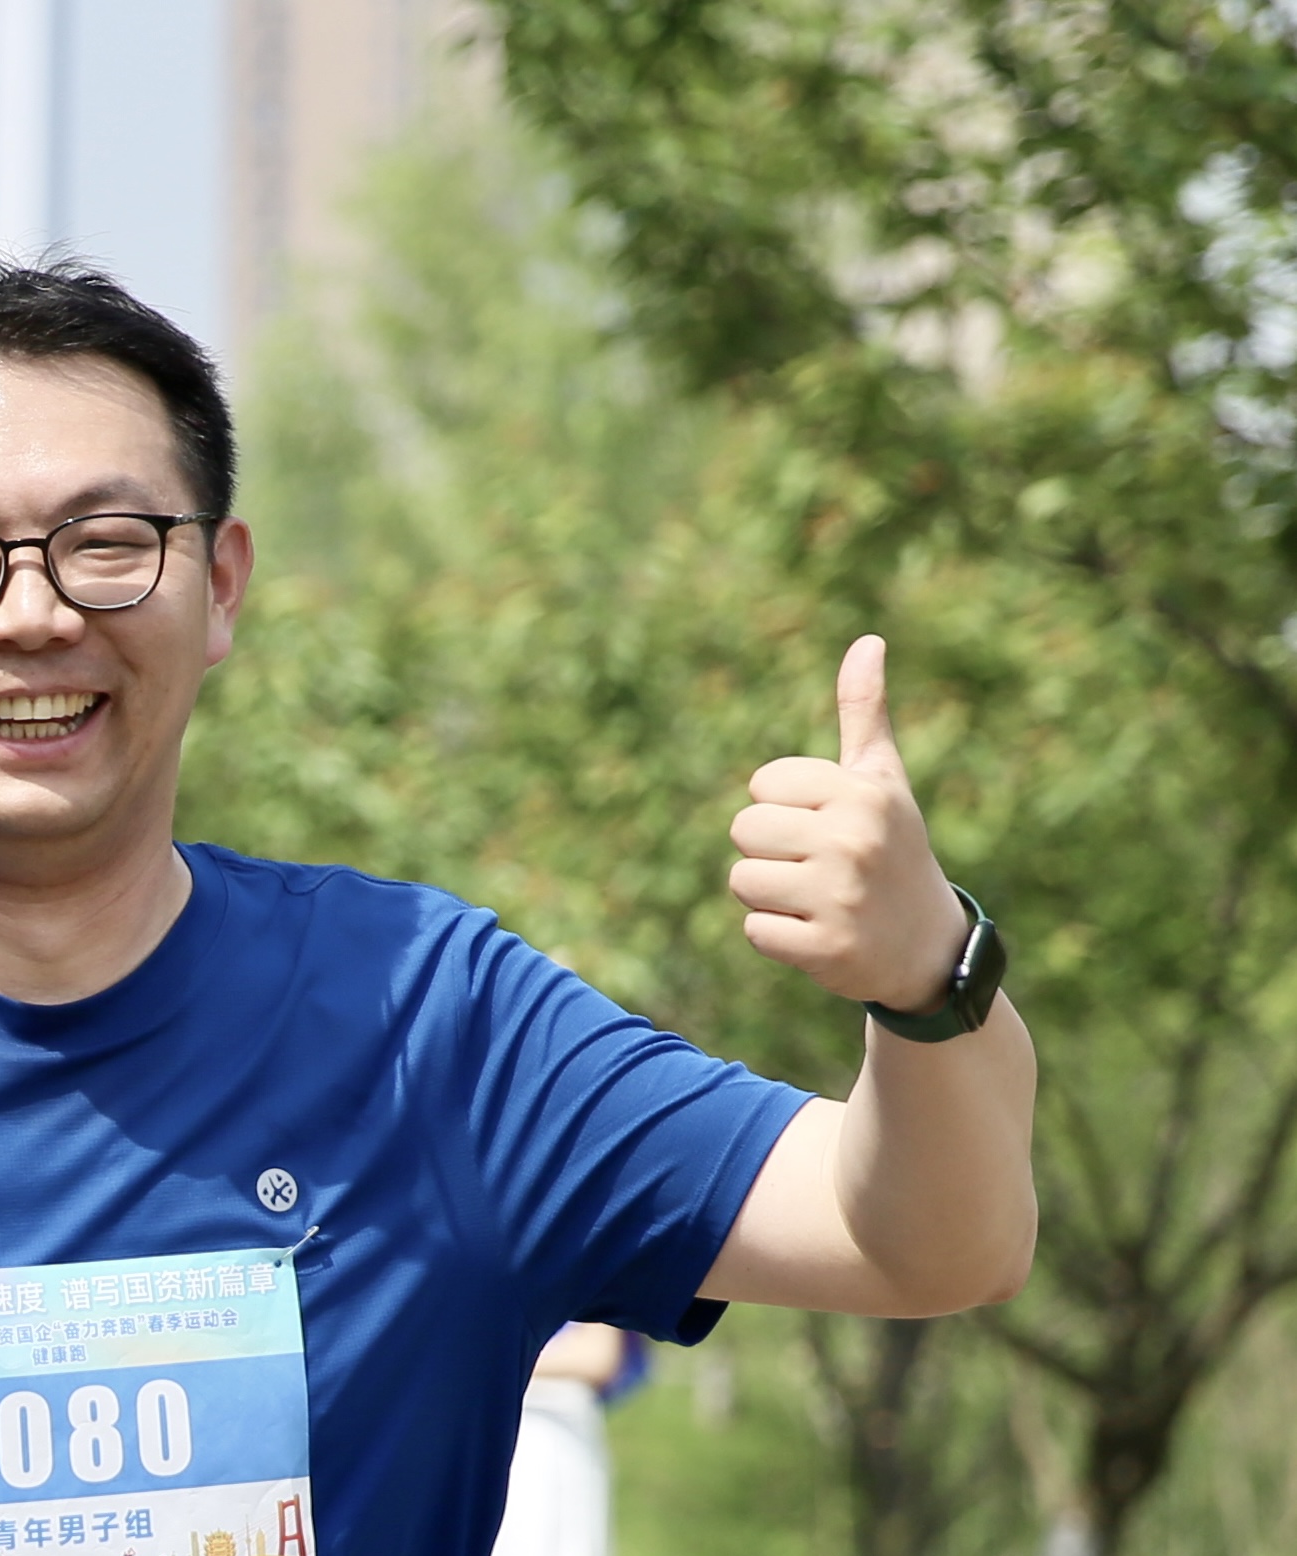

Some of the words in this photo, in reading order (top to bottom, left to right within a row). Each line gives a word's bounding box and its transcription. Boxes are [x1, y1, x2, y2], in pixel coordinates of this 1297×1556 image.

[61, 1263, 277, 1310] 谱写国资新篇章
[33, 1345, 87, 1366] 健康跑
